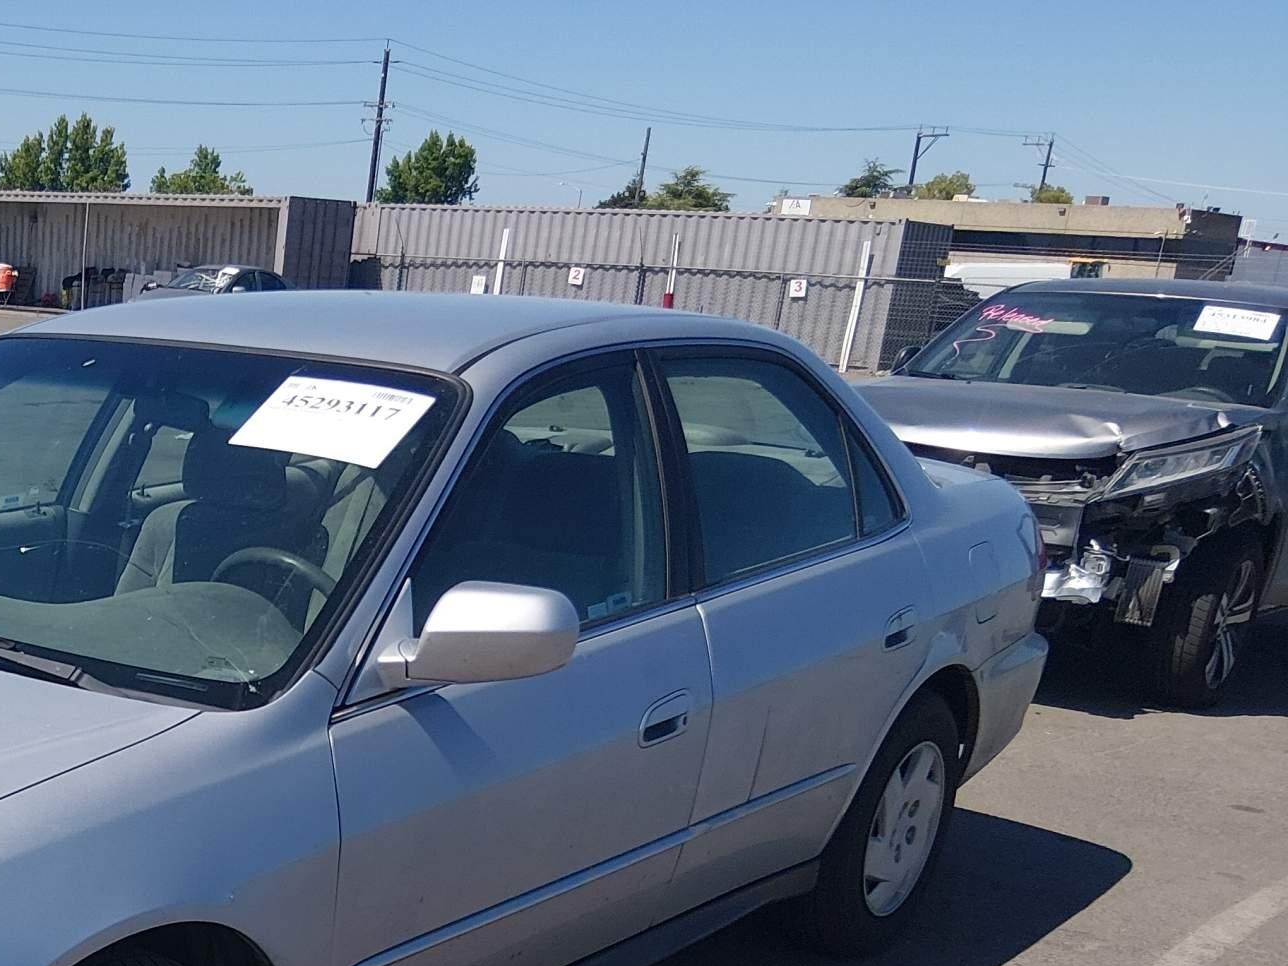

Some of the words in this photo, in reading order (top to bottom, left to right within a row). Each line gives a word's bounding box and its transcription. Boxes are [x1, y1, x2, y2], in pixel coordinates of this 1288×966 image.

[572, 269, 581, 280] 2
[794, 281, 803, 293] 3
[281, 394, 402, 421] 45293117
